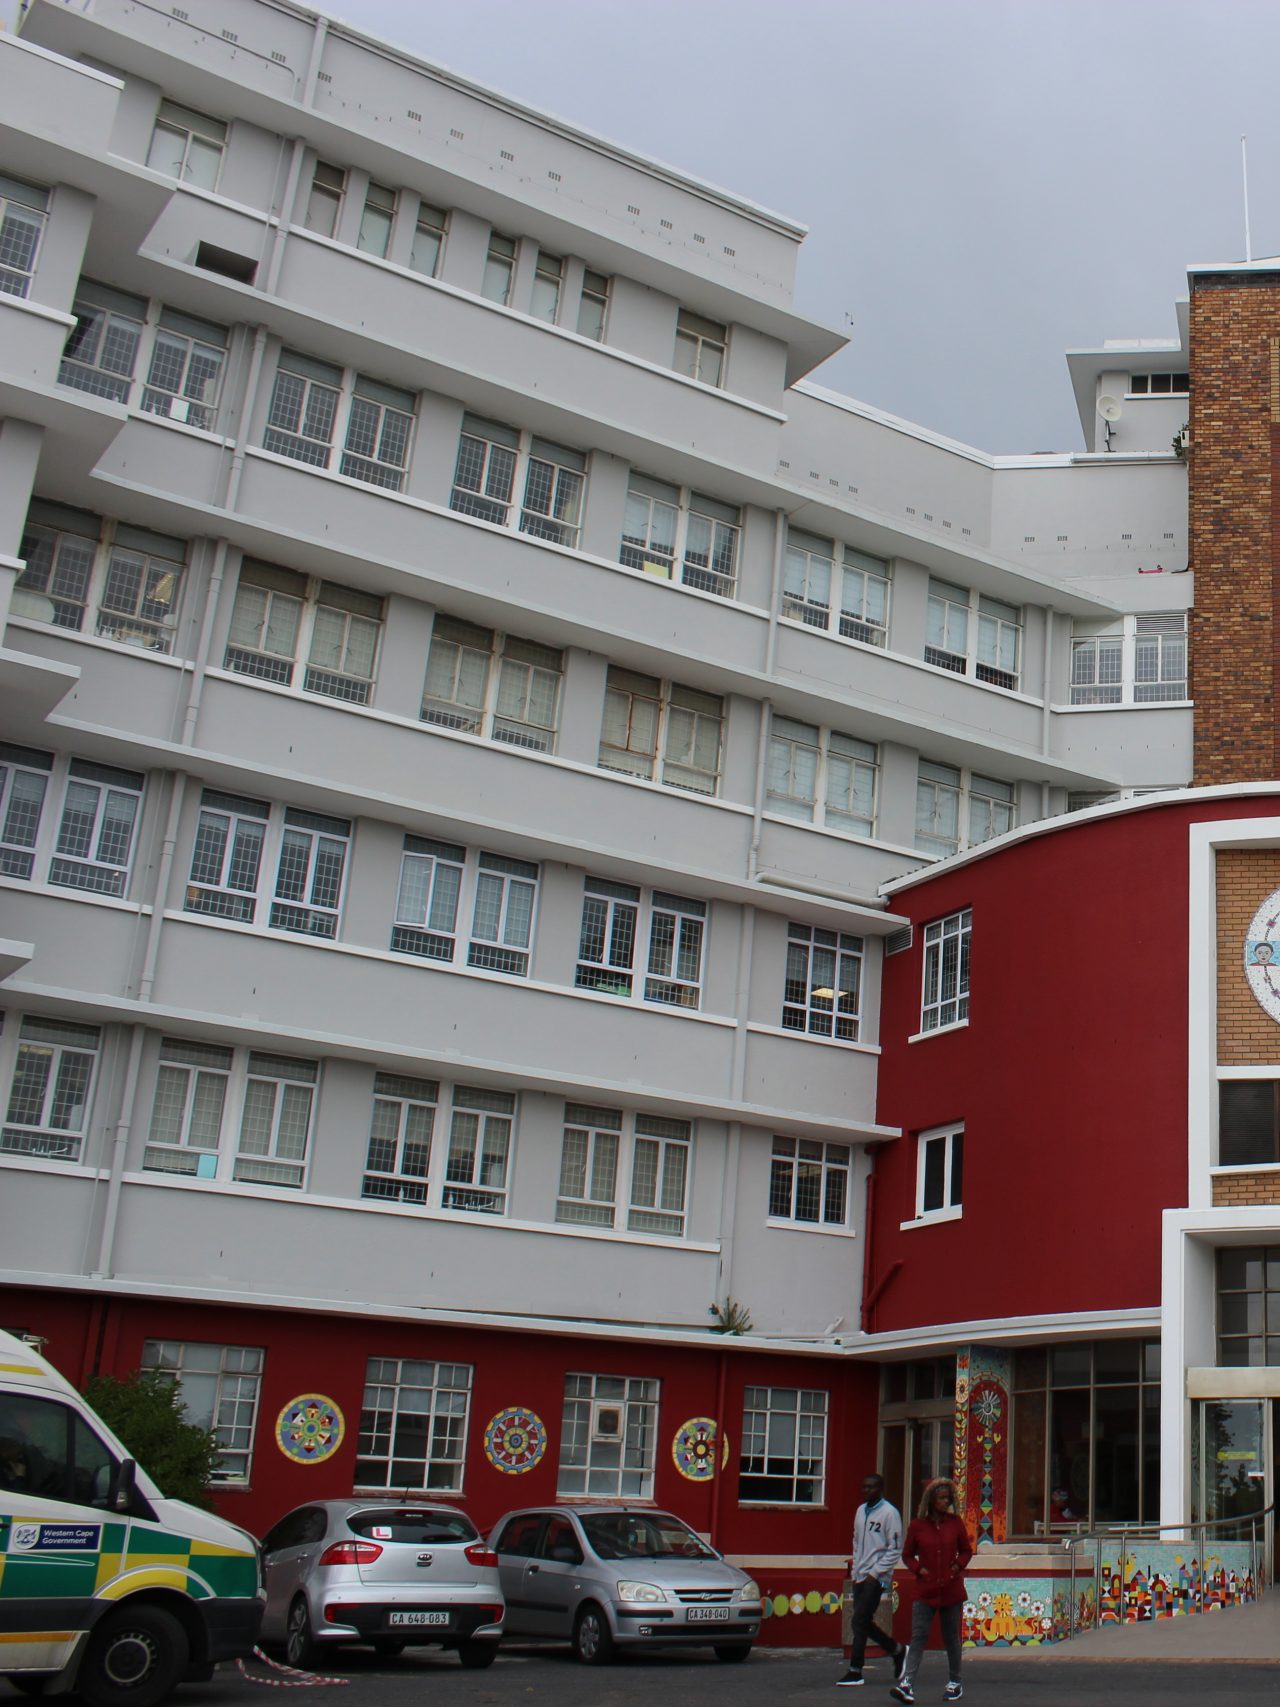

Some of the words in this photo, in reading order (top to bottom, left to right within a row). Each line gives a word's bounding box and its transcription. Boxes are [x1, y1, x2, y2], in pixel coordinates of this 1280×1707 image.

[869, 1521, 881, 1532] 72
[43, 1529, 74, 1537] Western
[75, 1529, 94, 1537] Cape
[376, 1527, 389, 1537] L
[392, 1613, 405, 1624] CA
[408, 1613, 447, 1624] 648-083
[689, 1609, 698, 1619] CA
[700, 1609, 727, 1619] 348-040
